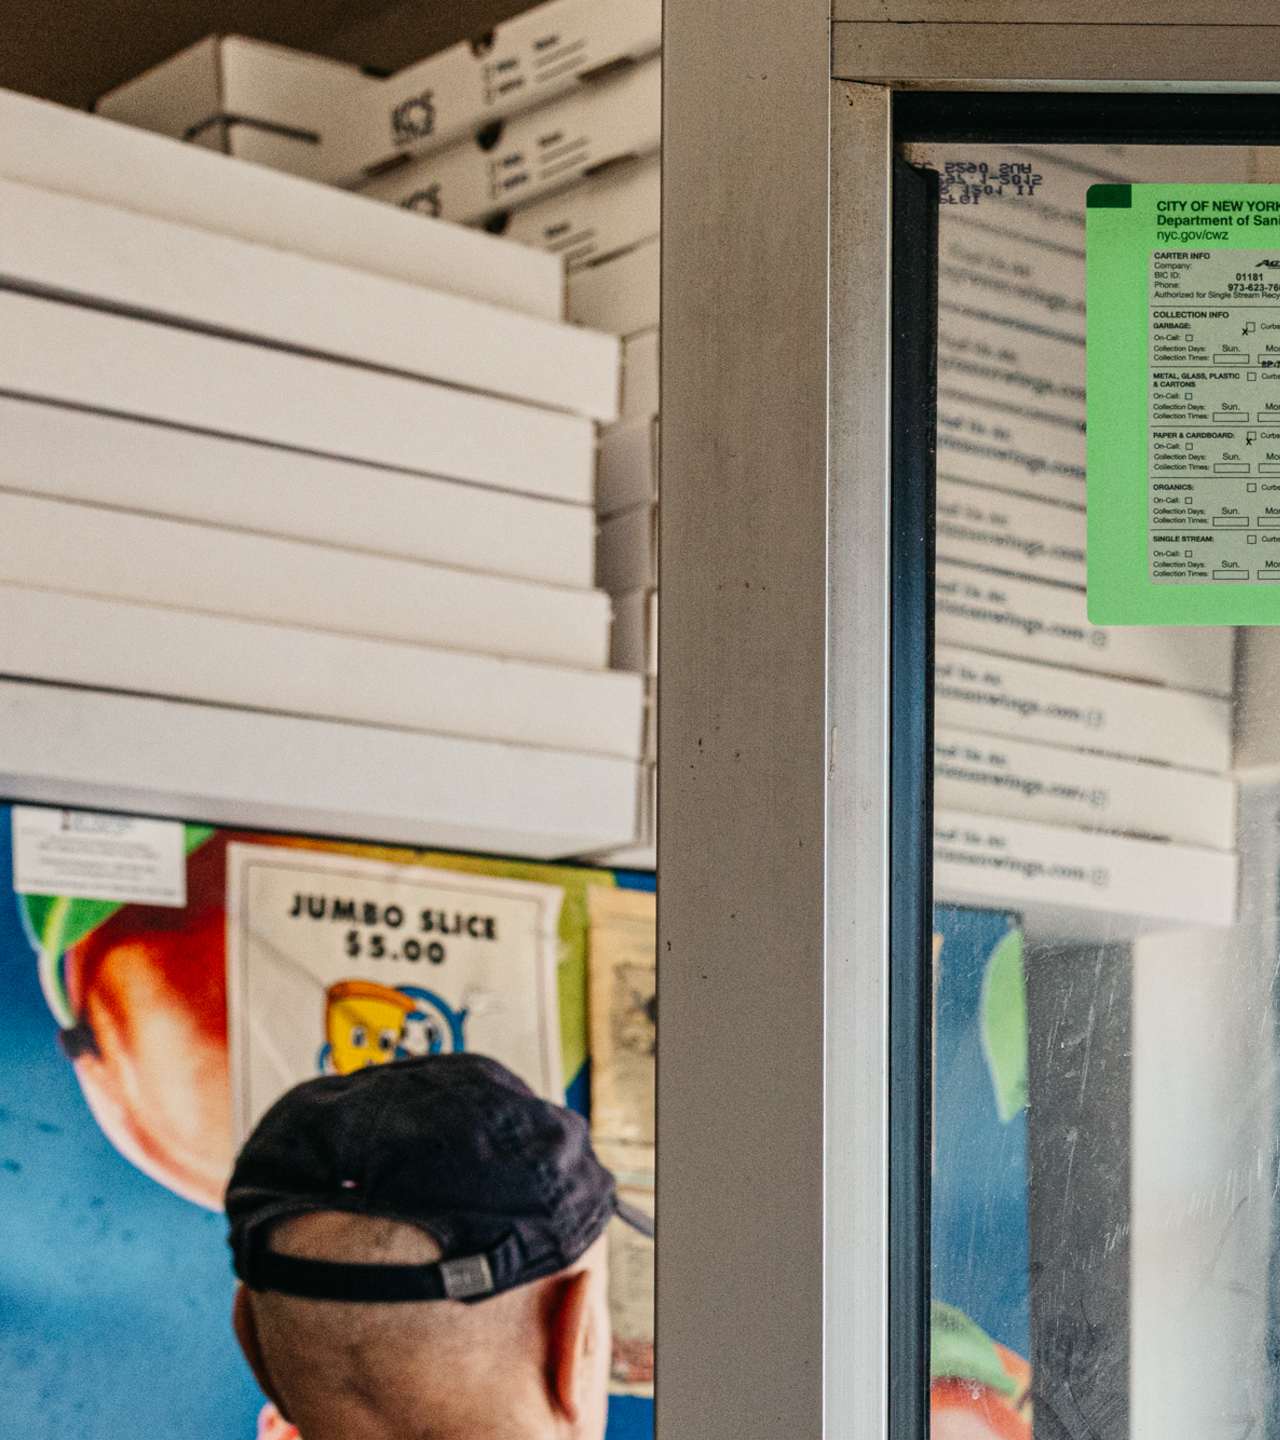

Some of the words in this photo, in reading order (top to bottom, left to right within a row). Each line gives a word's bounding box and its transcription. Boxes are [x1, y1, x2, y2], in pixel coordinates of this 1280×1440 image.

[1157, 201, 1188, 211] CITY
[1191, 201, 1207, 211] OF
[1212, 201, 1246, 211] NEW
[1157, 215, 1233, 227] Department
[1237, 215, 1249, 226] of
[1157, 230, 1229, 242] nyc.gov/cwz
[1236, 273, 1263, 281] 01181
[289, 894, 405, 929] JUMBO
[420, 909, 497, 940] SLICE
[346, 930, 445, 965] $5.00
